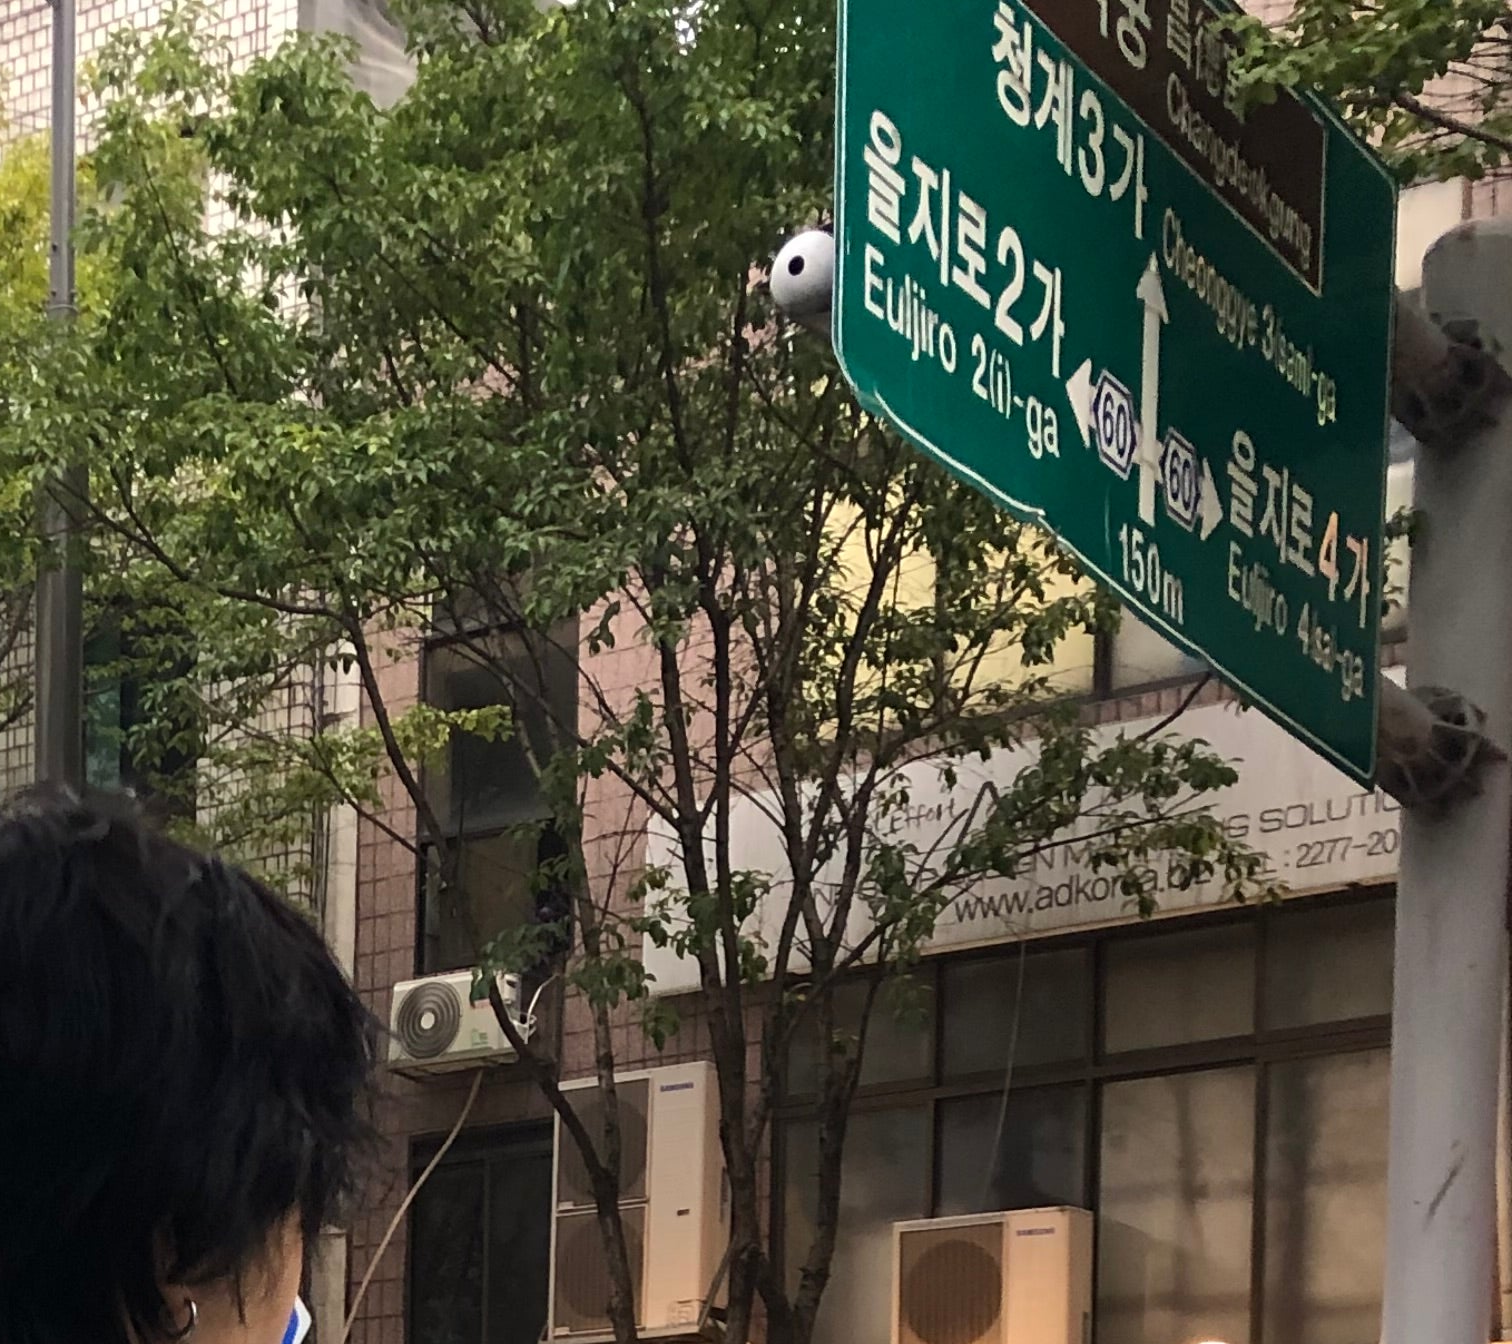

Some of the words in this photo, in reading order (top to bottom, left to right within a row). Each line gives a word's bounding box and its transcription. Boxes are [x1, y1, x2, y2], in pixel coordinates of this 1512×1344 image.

[991, 0, 1149, 240] 청계3가
[863, 109, 1065, 379] 을지로2가
[864, 242, 957, 374] Euljiro
[971, 332, 1061, 460] 2(i)-ga
[1102, 390, 1126, 458] 60
[1169, 450, 1192, 512] 60
[1227, 430, 1371, 629] 을지로4가
[1119, 522, 1184, 626] 150m
[1228, 540, 1289, 635] Euljiro
